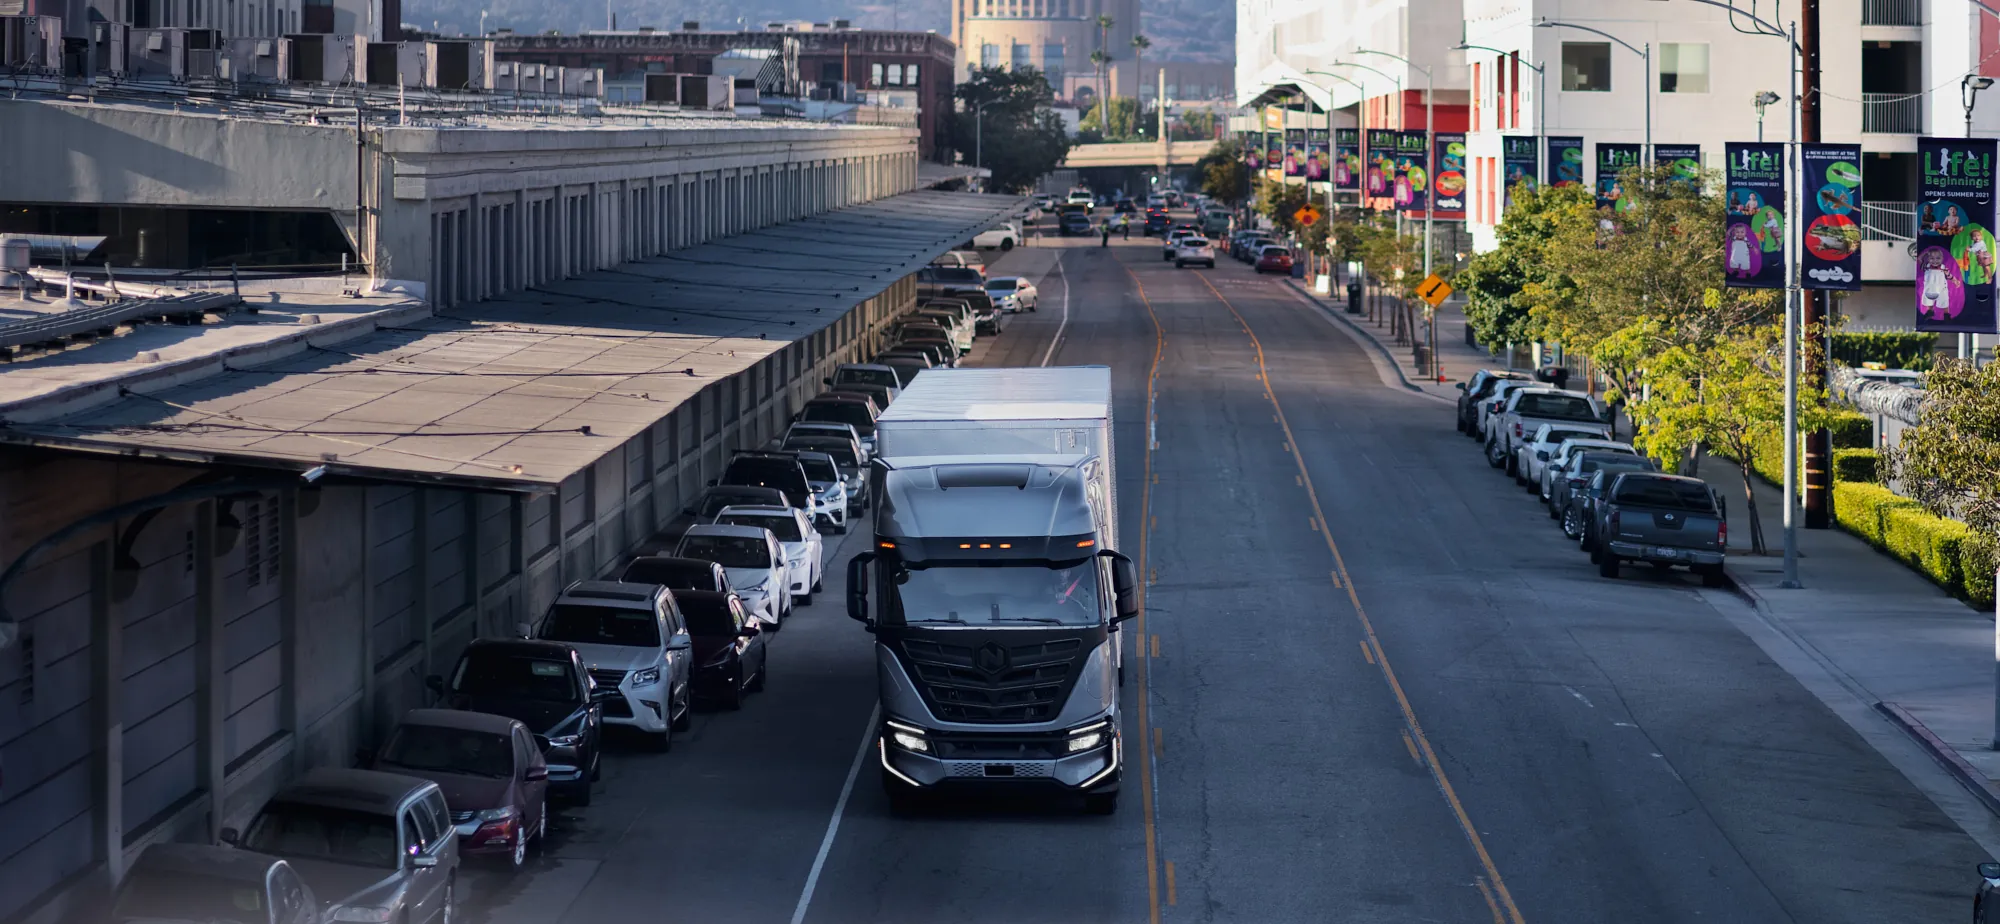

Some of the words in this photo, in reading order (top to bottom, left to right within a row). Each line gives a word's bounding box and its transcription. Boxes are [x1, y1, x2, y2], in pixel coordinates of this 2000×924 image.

[24, 17, 37, 25] 05
[1730, 149, 1780, 171] Life!
[1924, 148, 1990, 177] Life!
[1731, 170, 1780, 180] Beginnings
[1925, 176, 1990, 188] Beginnings
